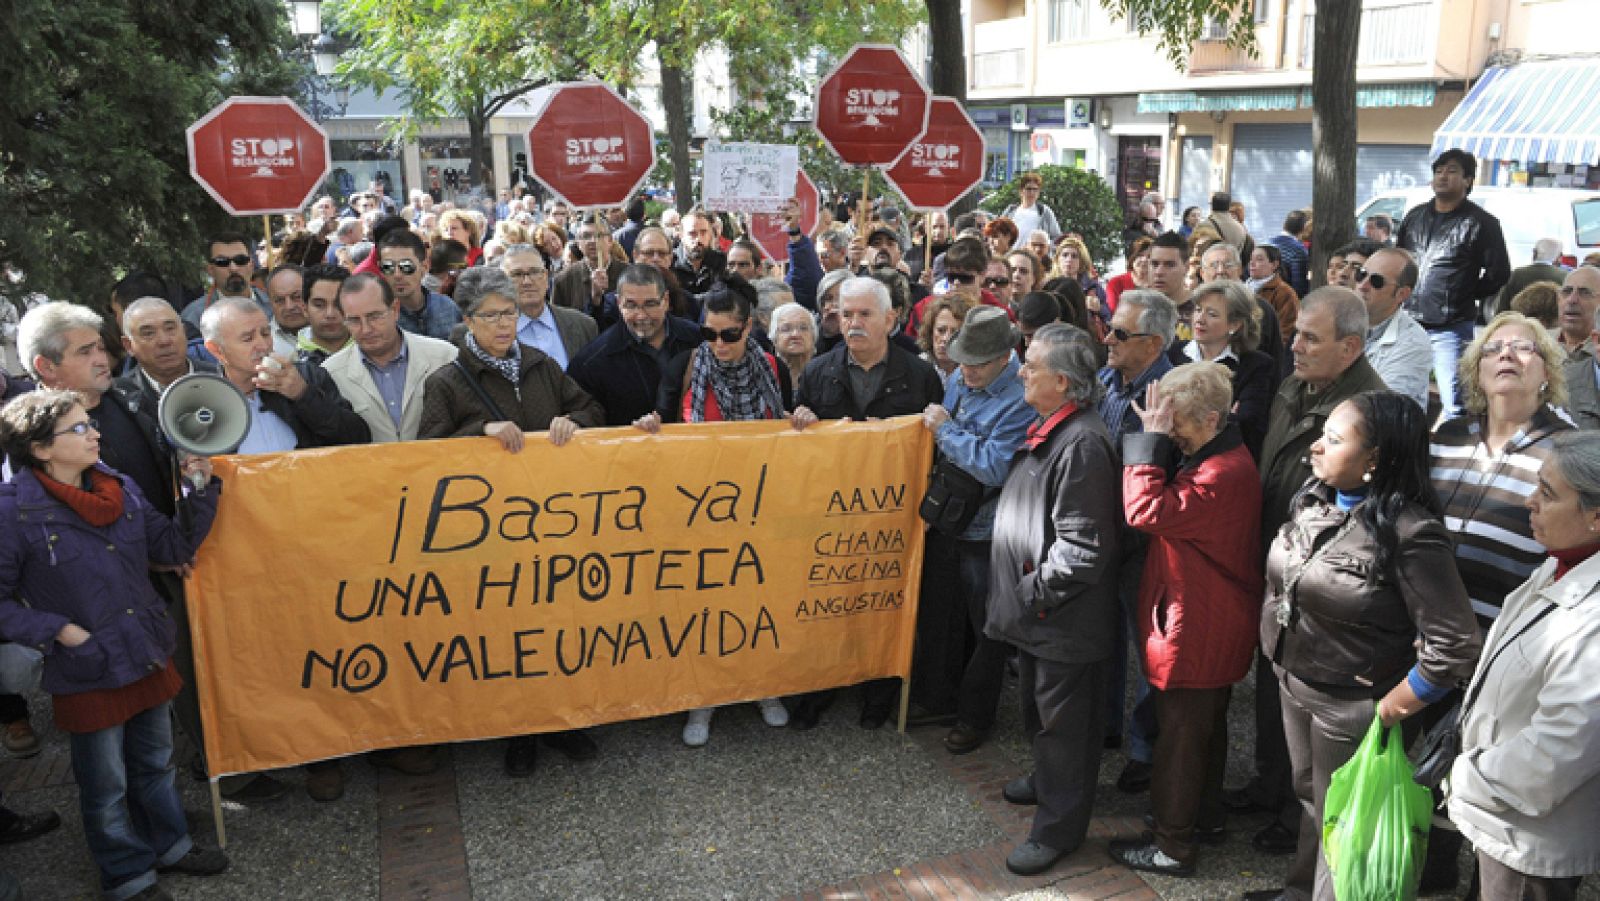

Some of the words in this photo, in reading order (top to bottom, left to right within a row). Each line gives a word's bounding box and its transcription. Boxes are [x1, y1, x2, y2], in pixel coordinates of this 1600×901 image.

[846, 89, 900, 105] STOP
[231, 138, 294, 155] STOP
[566, 137, 624, 155] STOP
[911, 143, 960, 159] STOP
[814, 529, 905, 555] CHANA
[335, 571, 452, 623] UNA
[301, 643, 388, 693] NO
